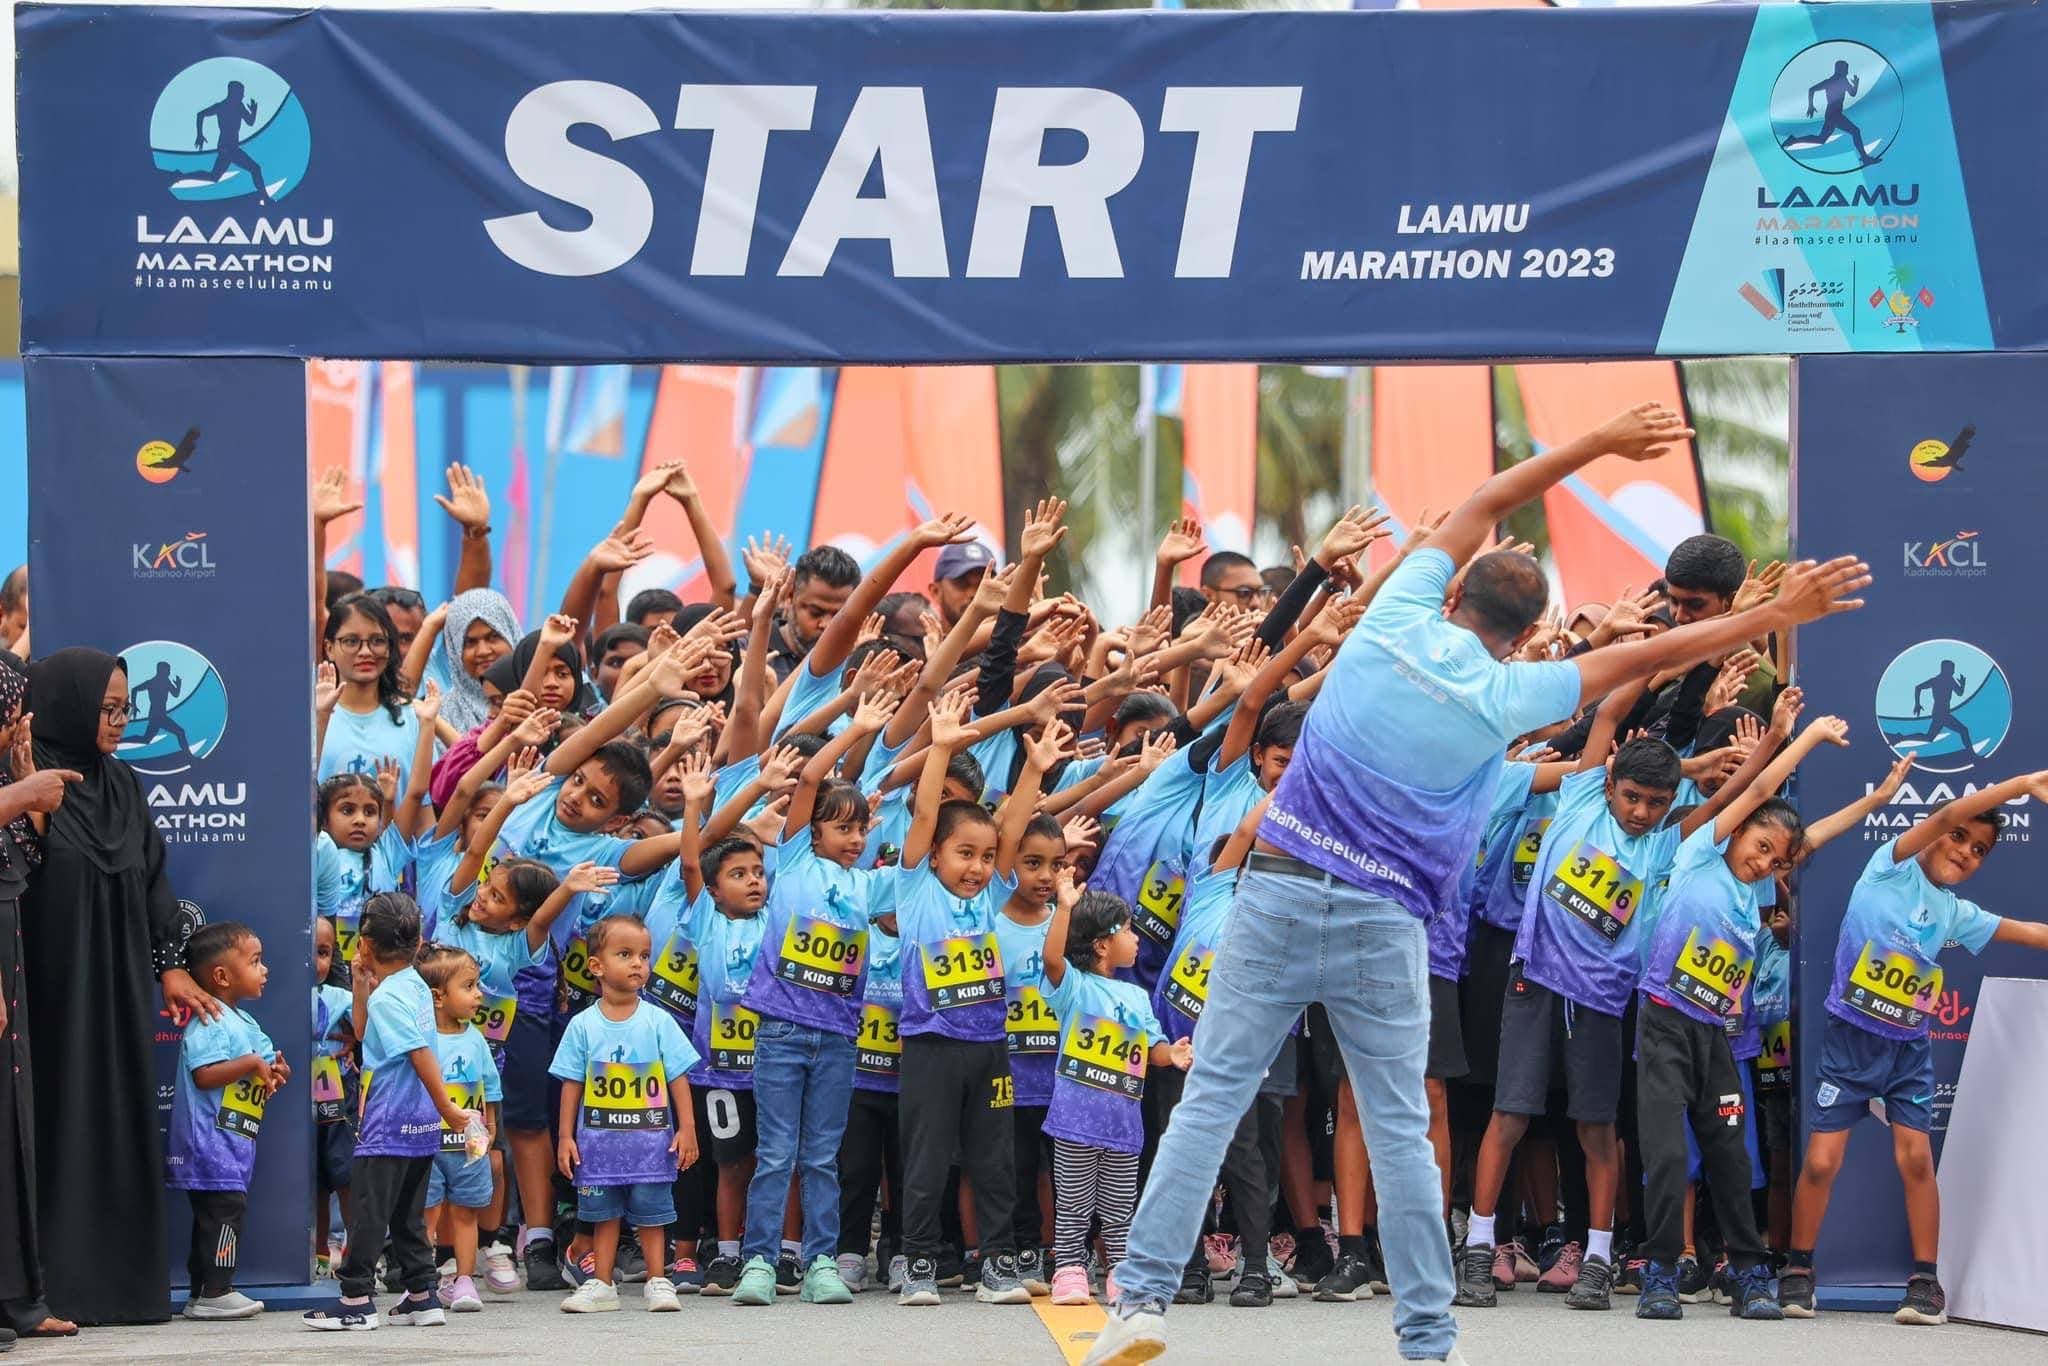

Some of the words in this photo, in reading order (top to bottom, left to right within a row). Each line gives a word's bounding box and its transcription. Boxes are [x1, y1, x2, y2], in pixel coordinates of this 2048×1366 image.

[483, 79, 1303, 278] START
[1756, 184, 1920, 209] LAAMU
[137, 216, 334, 246] LAAMU
[1397, 204, 1531, 236] LAAMU
[1756, 214, 1920, 231] MARATHON
[1755, 234, 1920, 245] #laamaseelulaamu
[136, 252, 333, 273] MARATHON
[1300, 249, 1512, 281] MARATHON
[1520, 248, 1615, 279] 2023
[135, 275, 333, 290] #laamaseelulaamu
[132, 542, 216, 568] KACL
[1903, 541, 1987, 567] KACL
[184, 569, 216, 579] Airport
[1954, 567, 1987, 579] Airport
[147, 783, 247, 807] AMU
[154, 813, 246, 829] ATHON
[165, 831, 246, 843] elulaamu
[1570, 856, 1634, 911] 3116
[1147, 880, 1182, 915] 31
[1568, 893, 1599, 920] KIDS
[1145, 916, 1171, 941] KIDS
[793, 931, 859, 965] 3009
[667, 951, 699, 981] 31
[933, 947, 996, 977] 3139
[1182, 957, 1211, 988] 31
[1691, 945, 1747, 990] 3068
[803, 970, 834, 986] KIDS
[1866, 959, 1935, 1000] 3064
[669, 989, 697, 1010] KIDS
[957, 985, 986, 999] KIDS
[1693, 985, 1719, 1006] KIDS
[1007, 999, 1058, 1021] 314
[1179, 993, 1203, 1015] KID
[1871, 999, 1903, 1019] KIDS
[470, 1005, 505, 1029] 59
[721, 1018, 755, 1041] 30
[1025, 1035, 1057, 1046] KIDS
[1077, 1028, 1142, 1066] 3146
[736, 1055, 755, 1065] KI
[861, 1053, 893, 1067] KIDS
[1086, 1066, 1117, 1085] KIDS
[235, 1079, 267, 1110] 30
[593, 1076, 659, 1099] 3010
[609, 1113, 640, 1125] KIDS
[1718, 1104, 1744, 1117] LUCKY
[443, 1133, 466, 1144] KID
